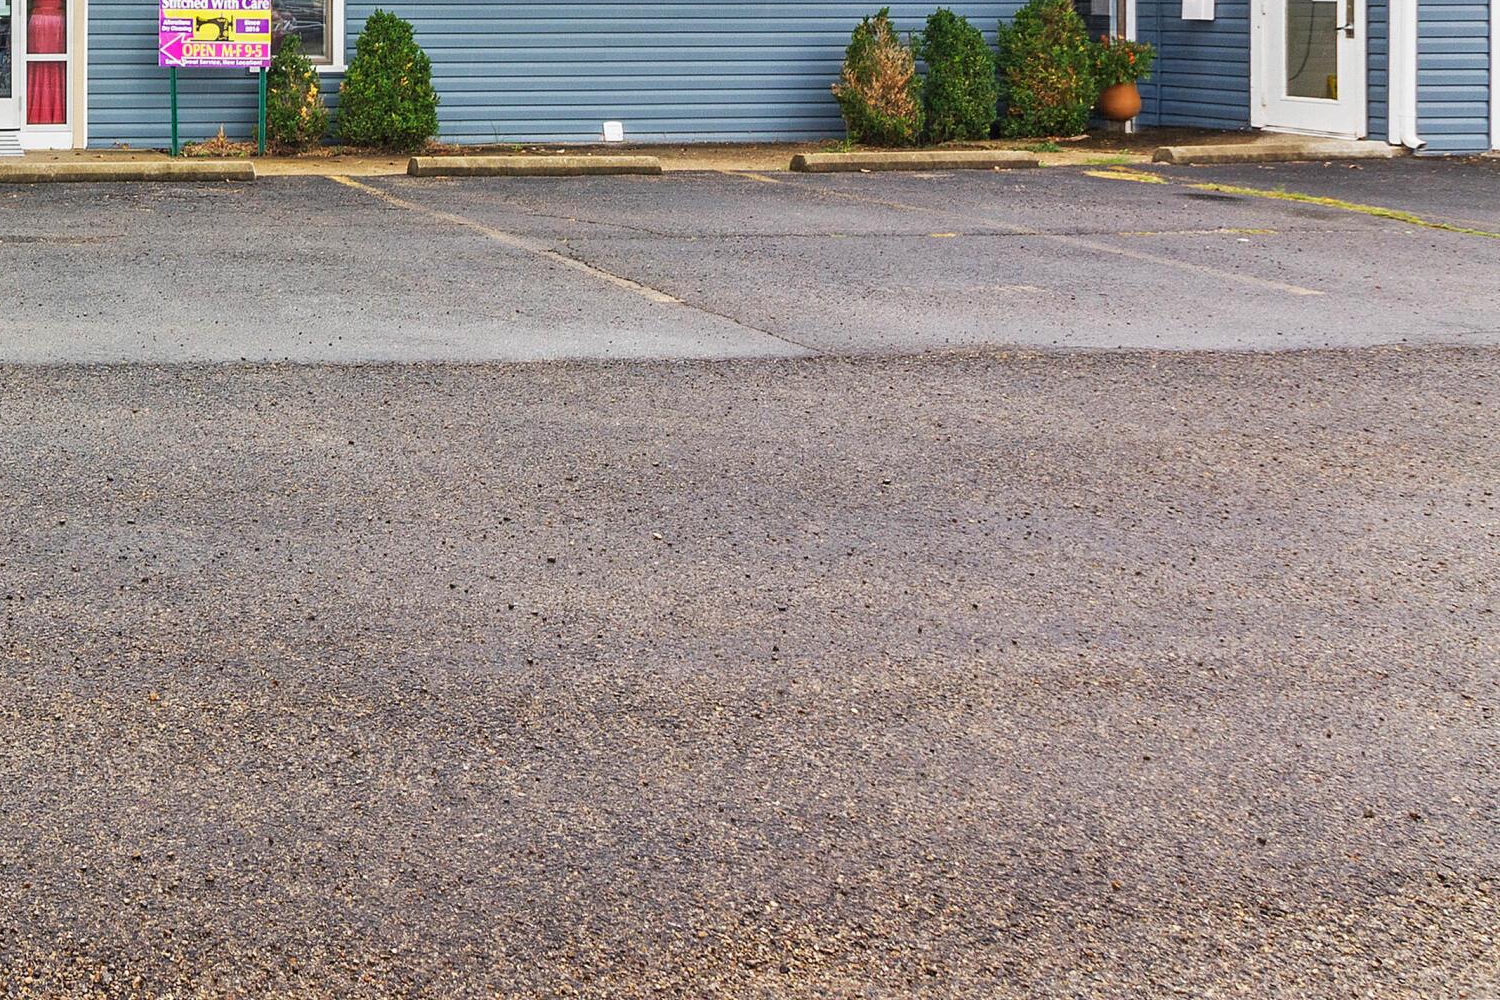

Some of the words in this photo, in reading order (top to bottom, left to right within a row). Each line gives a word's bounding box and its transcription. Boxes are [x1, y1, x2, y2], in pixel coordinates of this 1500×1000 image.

[182, 43, 216, 57] OPEN
[221, 43, 243, 57] M-F
[244, 43, 262, 57] 9-5
